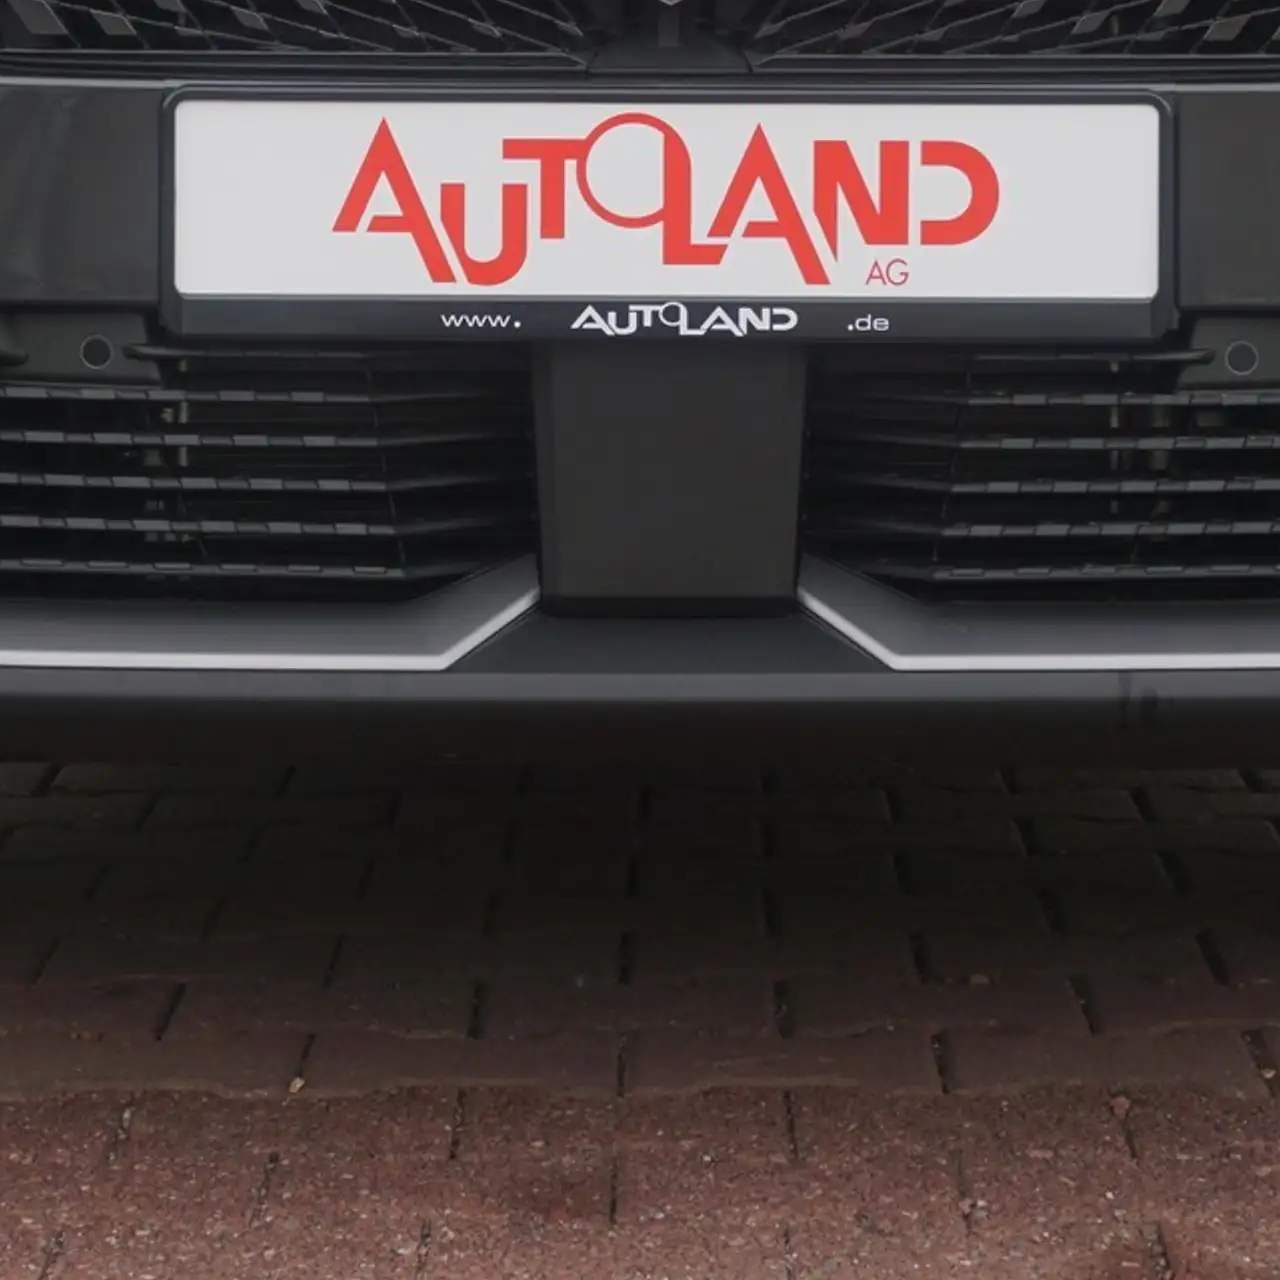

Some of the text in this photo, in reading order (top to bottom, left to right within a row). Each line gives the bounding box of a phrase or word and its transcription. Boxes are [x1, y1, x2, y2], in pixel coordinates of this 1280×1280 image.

[865, 259, 910, 287] AG
[440, 301, 890, 337] www. AUTOLAND .de
